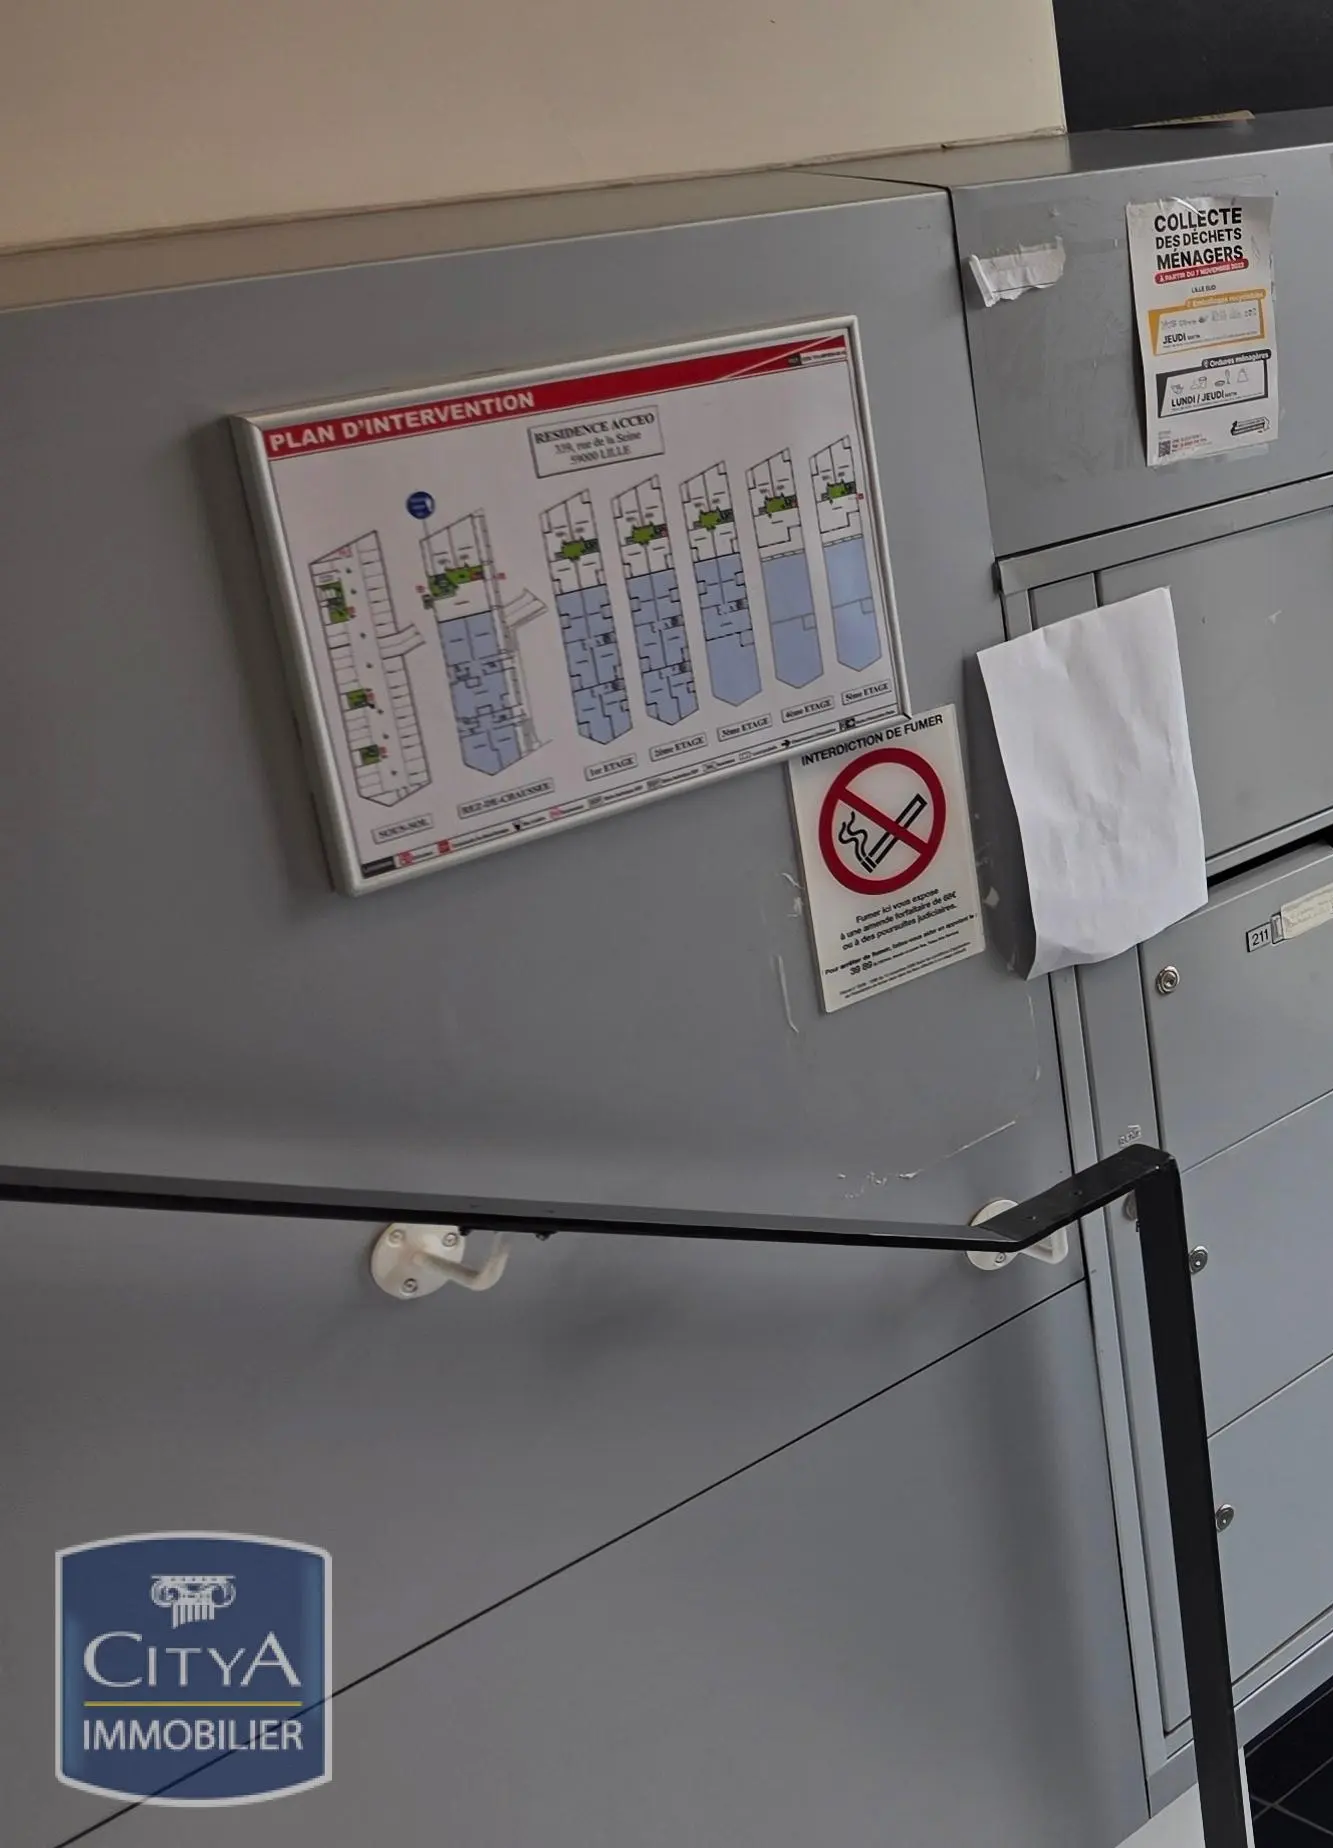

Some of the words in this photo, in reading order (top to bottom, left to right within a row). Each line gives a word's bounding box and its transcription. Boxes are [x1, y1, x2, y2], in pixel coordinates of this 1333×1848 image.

[1154, 207, 1242, 233] COLLECTE
[1156, 234, 1180, 250] DES
[1183, 227, 1242, 246] DÉCHETS
[1156, 245, 1244, 271] MÉNAGERS
[1163, 333, 1186, 345] JEUDI
[1171, 395, 1196, 407] LUNDI
[1202, 390, 1225, 402] JEUDI
[269, 425, 336, 452] PLAN
[342, 392, 535, 439] D'INTERVENTION
[534, 421, 608, 445] RESIDENCE
[801, 732, 884, 767] INTERDICTION
[886, 726, 902, 740] DE
[904, 714, 944, 735] FUMER
[855, 908, 881, 924] Fumer
[882, 905, 892, 914] ici
[892, 897, 911, 911] vous
[911, 888, 940, 904] expose
[846, 927, 862, 938] une
[863, 915, 894, 933] amende
[860, 930, 876, 943] des
[1251, 928, 1269, 946] 211
